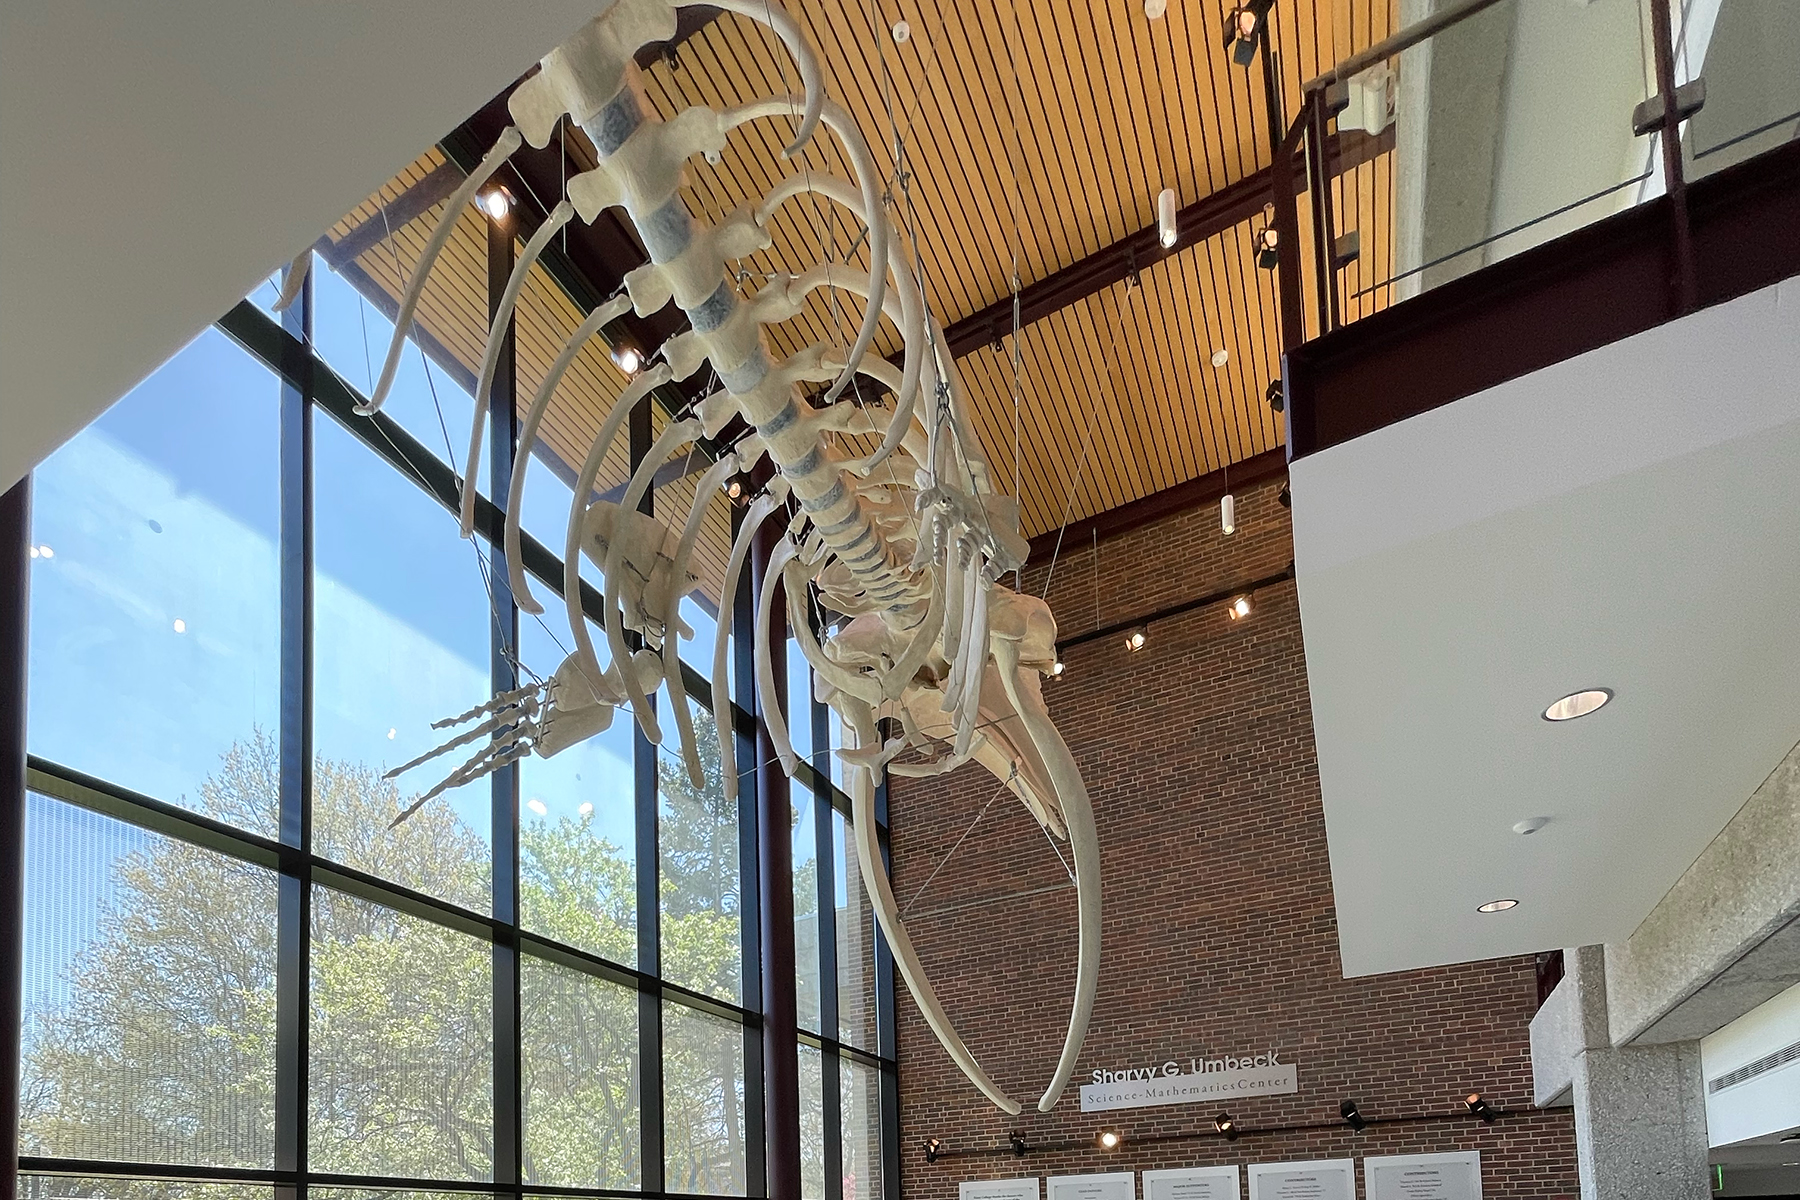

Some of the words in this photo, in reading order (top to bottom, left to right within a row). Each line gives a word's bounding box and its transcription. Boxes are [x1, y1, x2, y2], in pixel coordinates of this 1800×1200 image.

[1092, 1066, 1157, 1085] Sharvy
[1162, 1061, 1185, 1077] G.
[1191, 1050, 1280, 1074] Umbeck
